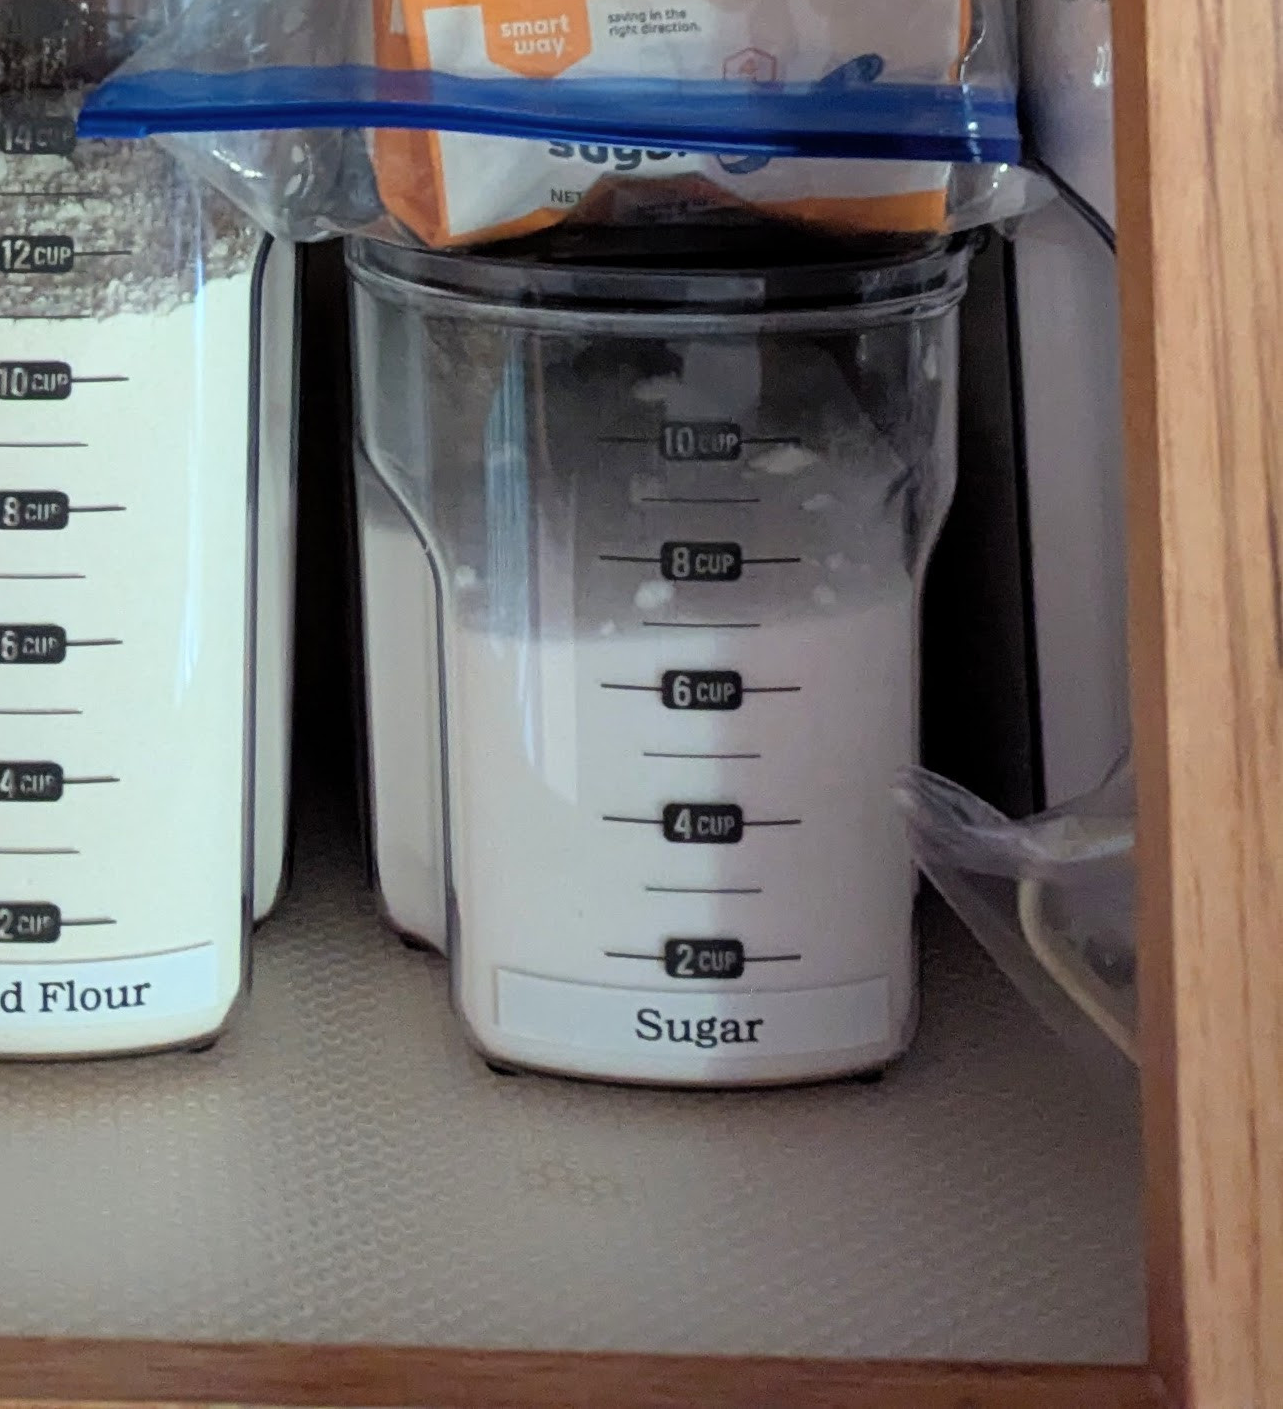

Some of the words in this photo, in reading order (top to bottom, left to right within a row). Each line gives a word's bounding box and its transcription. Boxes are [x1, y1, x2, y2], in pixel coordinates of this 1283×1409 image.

[500, 13, 571, 38] smart
[607, 10, 646, 25] saving
[649, 9, 663, 21] in
[665, 8, 687, 20] the
[608, 24, 637, 37] right
[640, 21, 702, 36] direction.
[514, 37, 566, 58] way
[4, 121, 31, 152] 14
[550, 187, 582, 204] NET
[2, 240, 31, 270] 12
[34, 246, 72, 266] CUP
[31, 373, 69, 393] CUP
[666, 426, 693, 458] 10
[3, 496, 19, 527] 8
[24, 503, 61, 522] CUP
[672, 547, 691, 578] 8
[695, 553, 735, 574] CUP
[1, 631, 18, 661] 6
[22, 637, 59, 656] CUP
[672, 676, 692, 708] 6
[696, 682, 736, 703] CUP
[0, 769, 14, 799] 4
[20, 775, 56, 794] CUP
[674, 808, 693, 840] 4
[697, 815, 736, 836] CUP
[17, 915, 53, 935] CUP
[676, 944, 695, 976] 2
[697, 950, 737, 971] CUP
[38, 979, 152, 1012] Flour
[635, 1008, 764, 1048] Sugar
